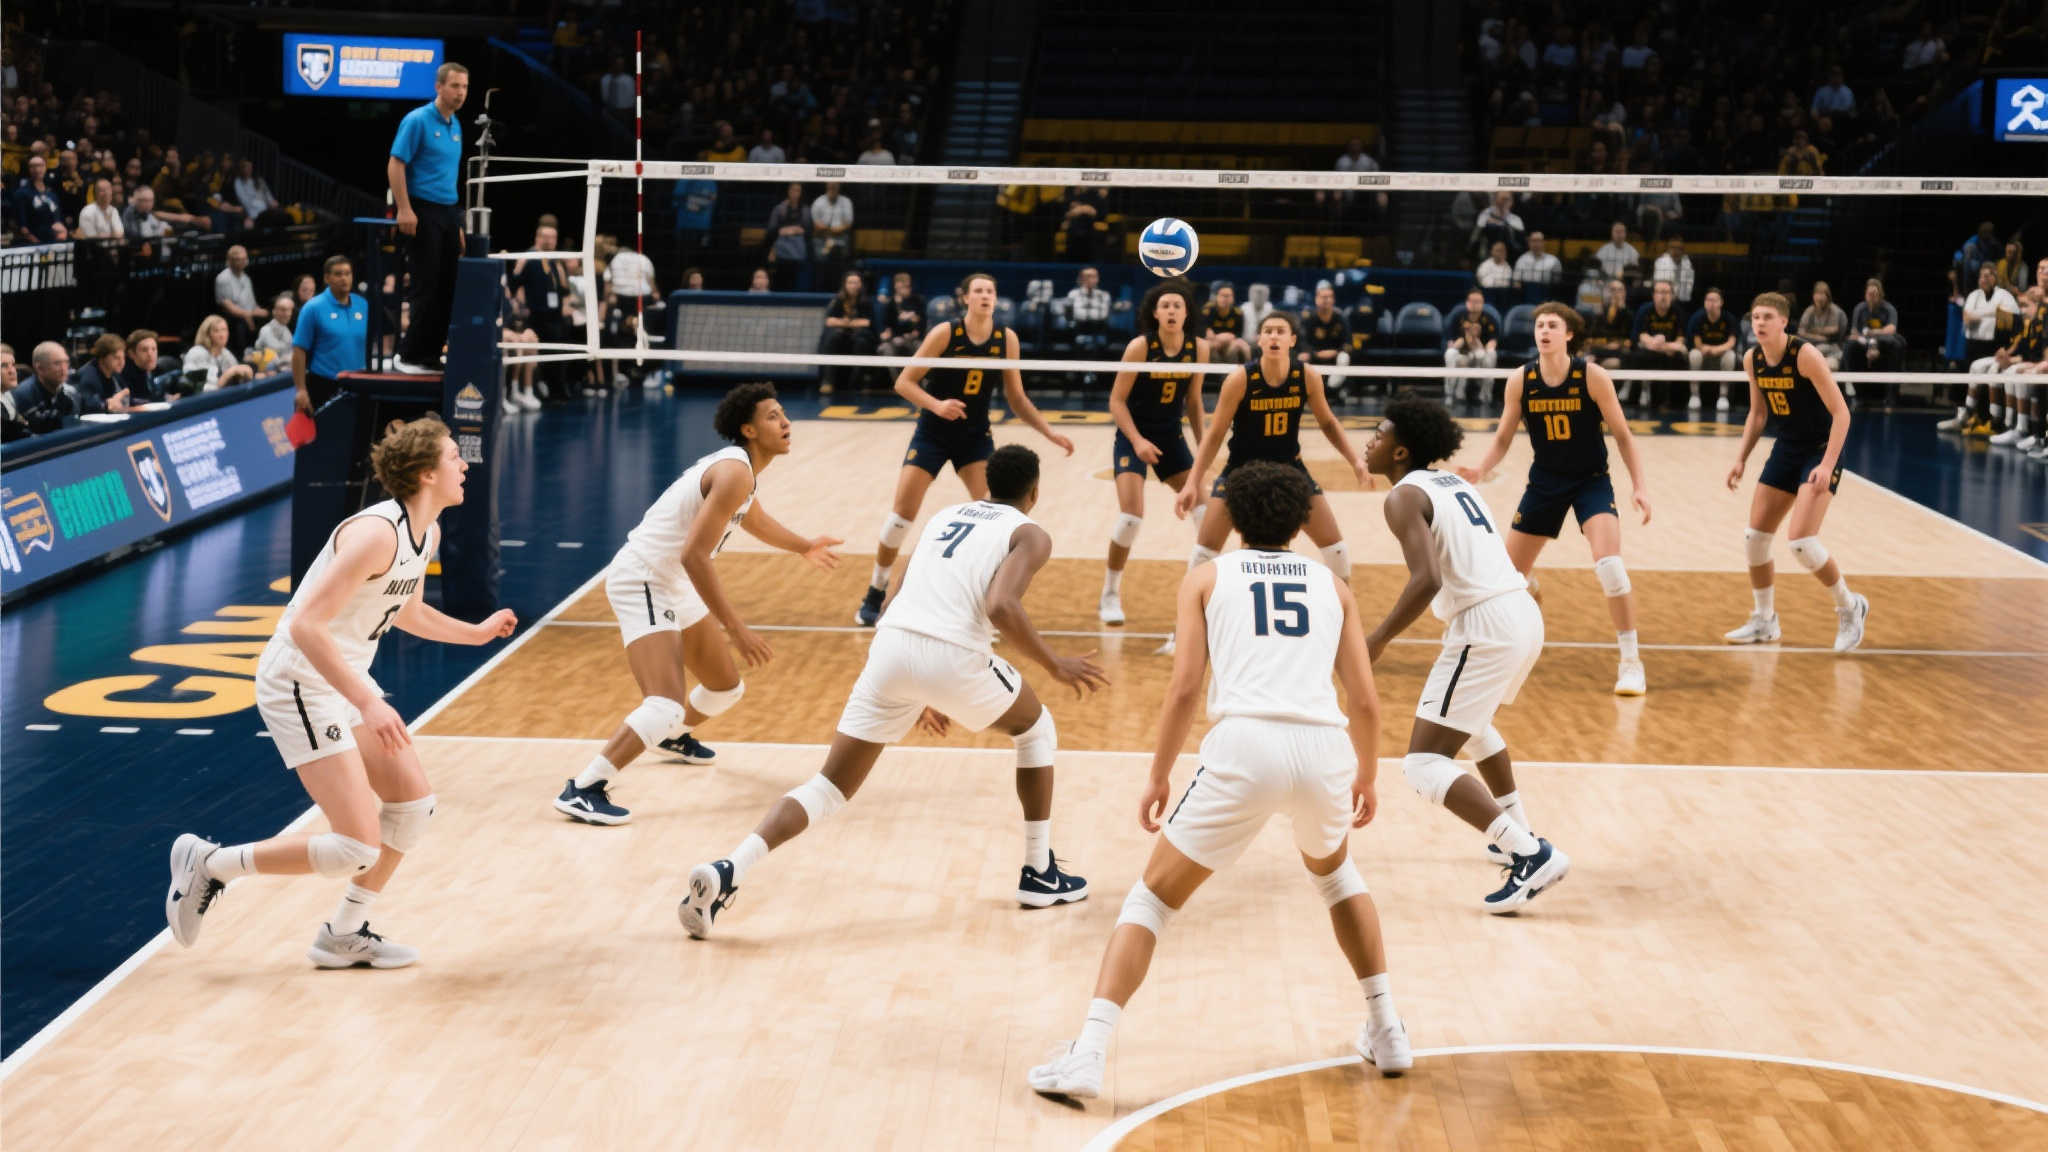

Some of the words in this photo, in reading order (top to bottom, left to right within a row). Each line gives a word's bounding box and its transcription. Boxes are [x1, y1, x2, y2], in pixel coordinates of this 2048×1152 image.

[963, 369, 984, 395] 8
[1160, 381, 1177, 404] 9
[1264, 411, 1289, 436] 18
[1543, 414, 1572, 441] 10
[1249, 581, 1310, 637] 15
